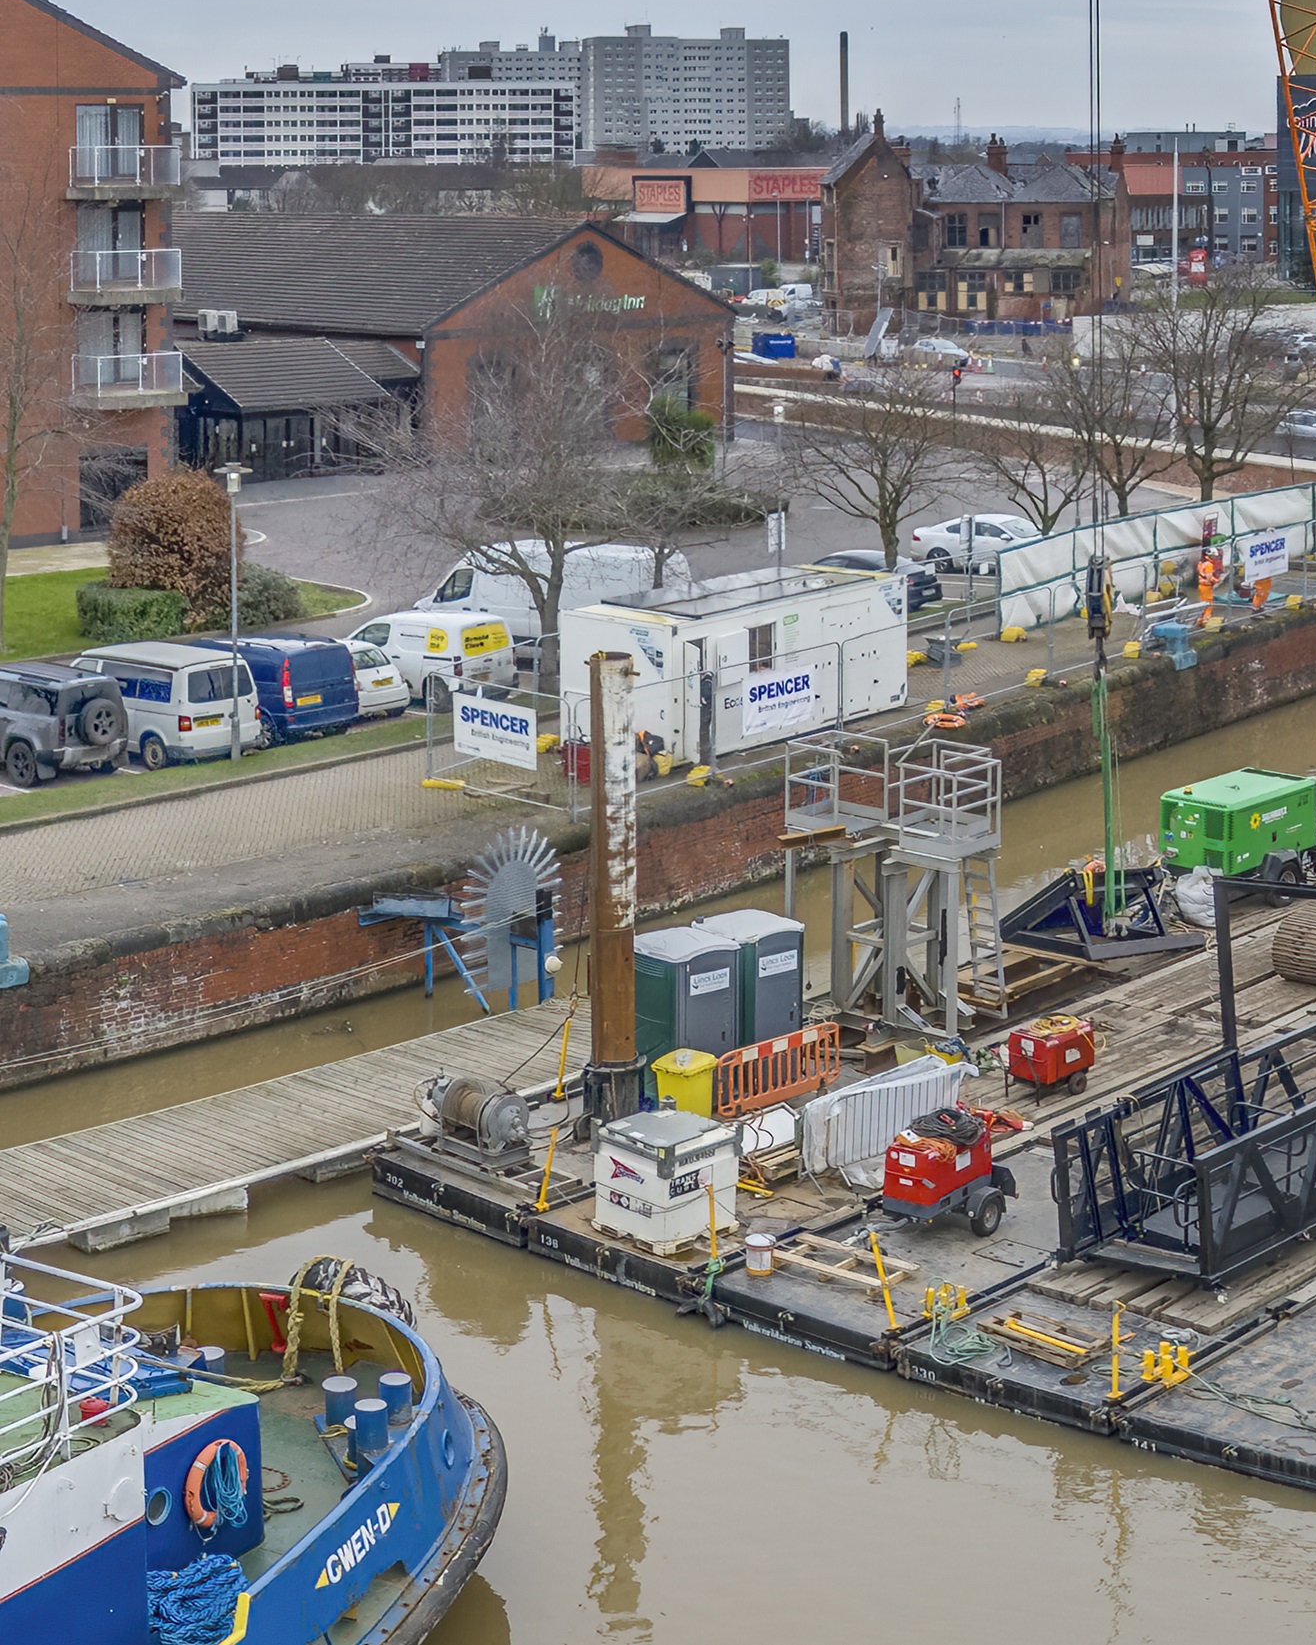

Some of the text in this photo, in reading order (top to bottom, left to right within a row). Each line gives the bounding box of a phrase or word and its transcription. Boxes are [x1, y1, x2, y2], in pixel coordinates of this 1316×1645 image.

[638, 184, 681, 202] STAPLES
[753, 173, 819, 195] STAPLES
[624, 294, 646, 310] Inn
[1249, 538, 1286, 558] SPENCER
[749, 674, 810, 703] SPENCER
[460, 705, 530, 737] SPENCER
[386, 1172, 404, 1188] 302
[911, 1364, 936, 1382] 330
[1131, 1437, 1157, 1453] 341
